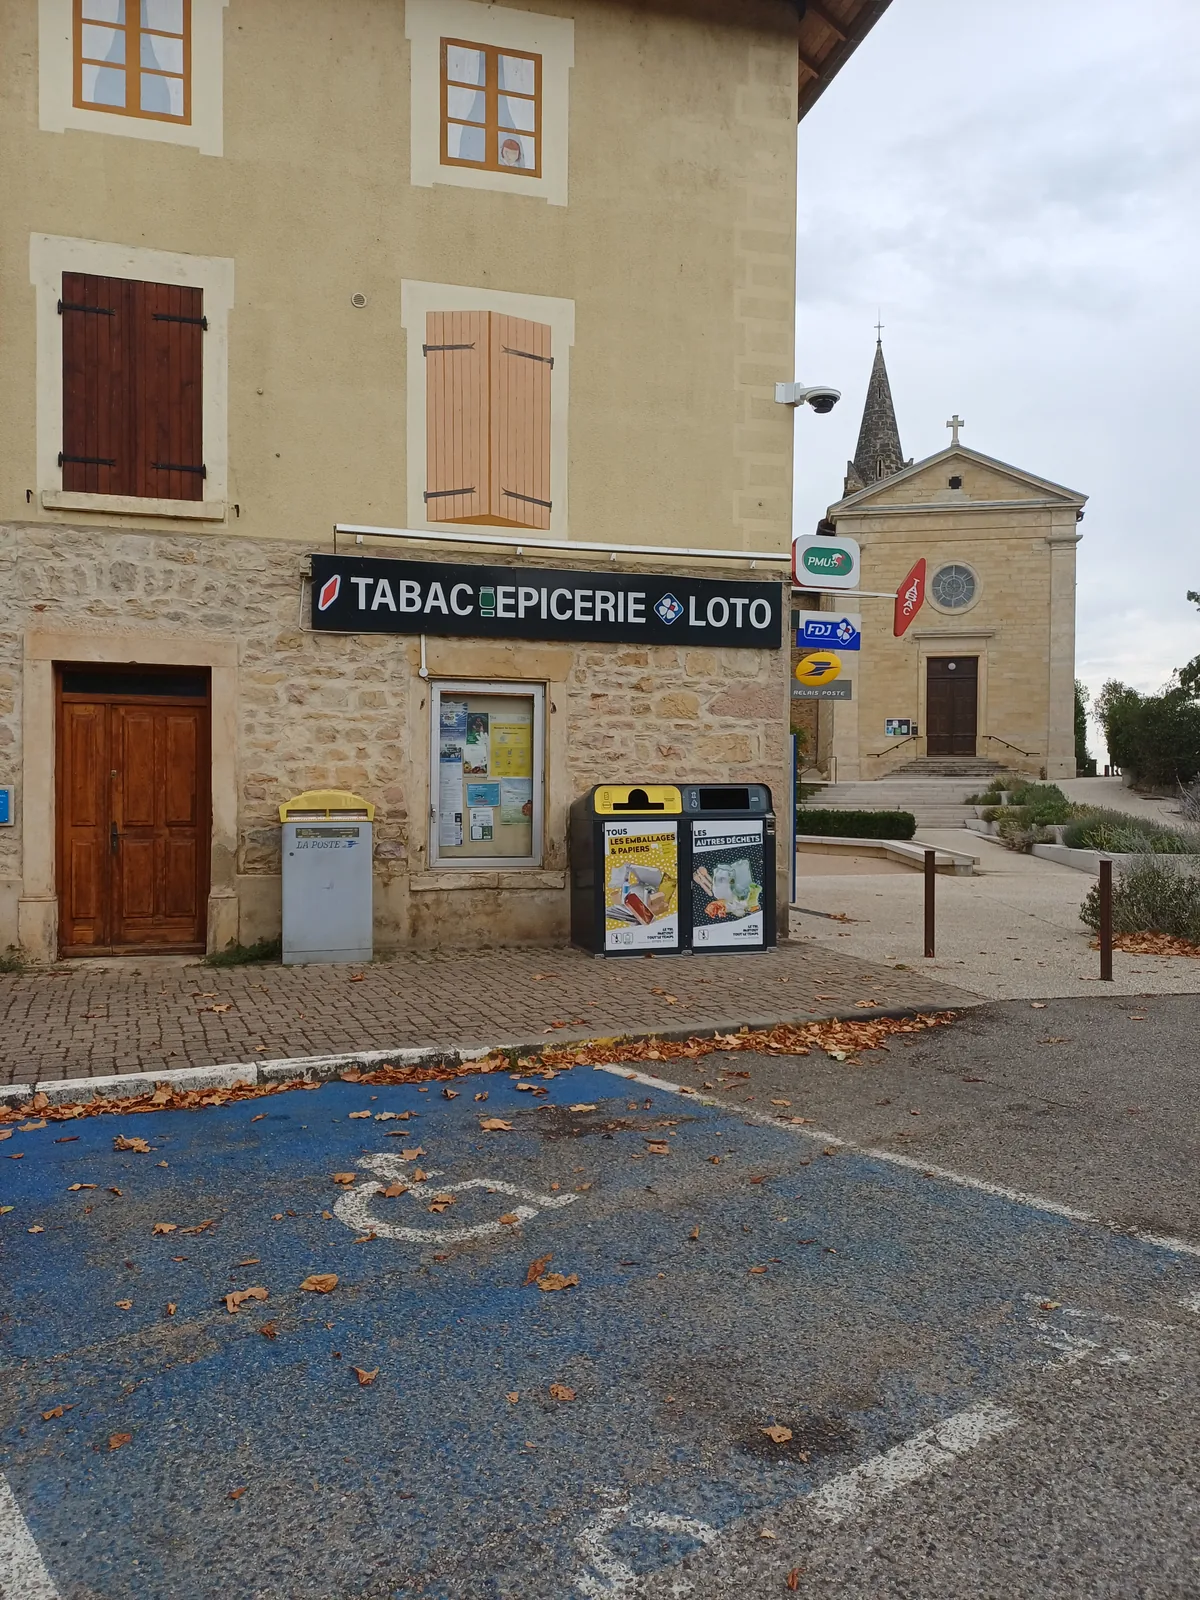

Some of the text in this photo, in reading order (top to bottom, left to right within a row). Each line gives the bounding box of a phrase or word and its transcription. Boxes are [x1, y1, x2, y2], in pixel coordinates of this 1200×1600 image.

[807, 556, 832, 567] PMU
[903, 578, 920, 616] TABAC
[350, 576, 772, 630] TABAC EPICERIE LOTO
[807, 623, 832, 636] FDJ
[606, 828, 628, 836] TOUS
[626, 834, 676, 844] EMBALLAGES
[696, 835, 760, 846] AUTRES DÉCHETS
[296, 841, 341, 849] LA POSTE
[618, 846, 650, 854] PAPIERS
